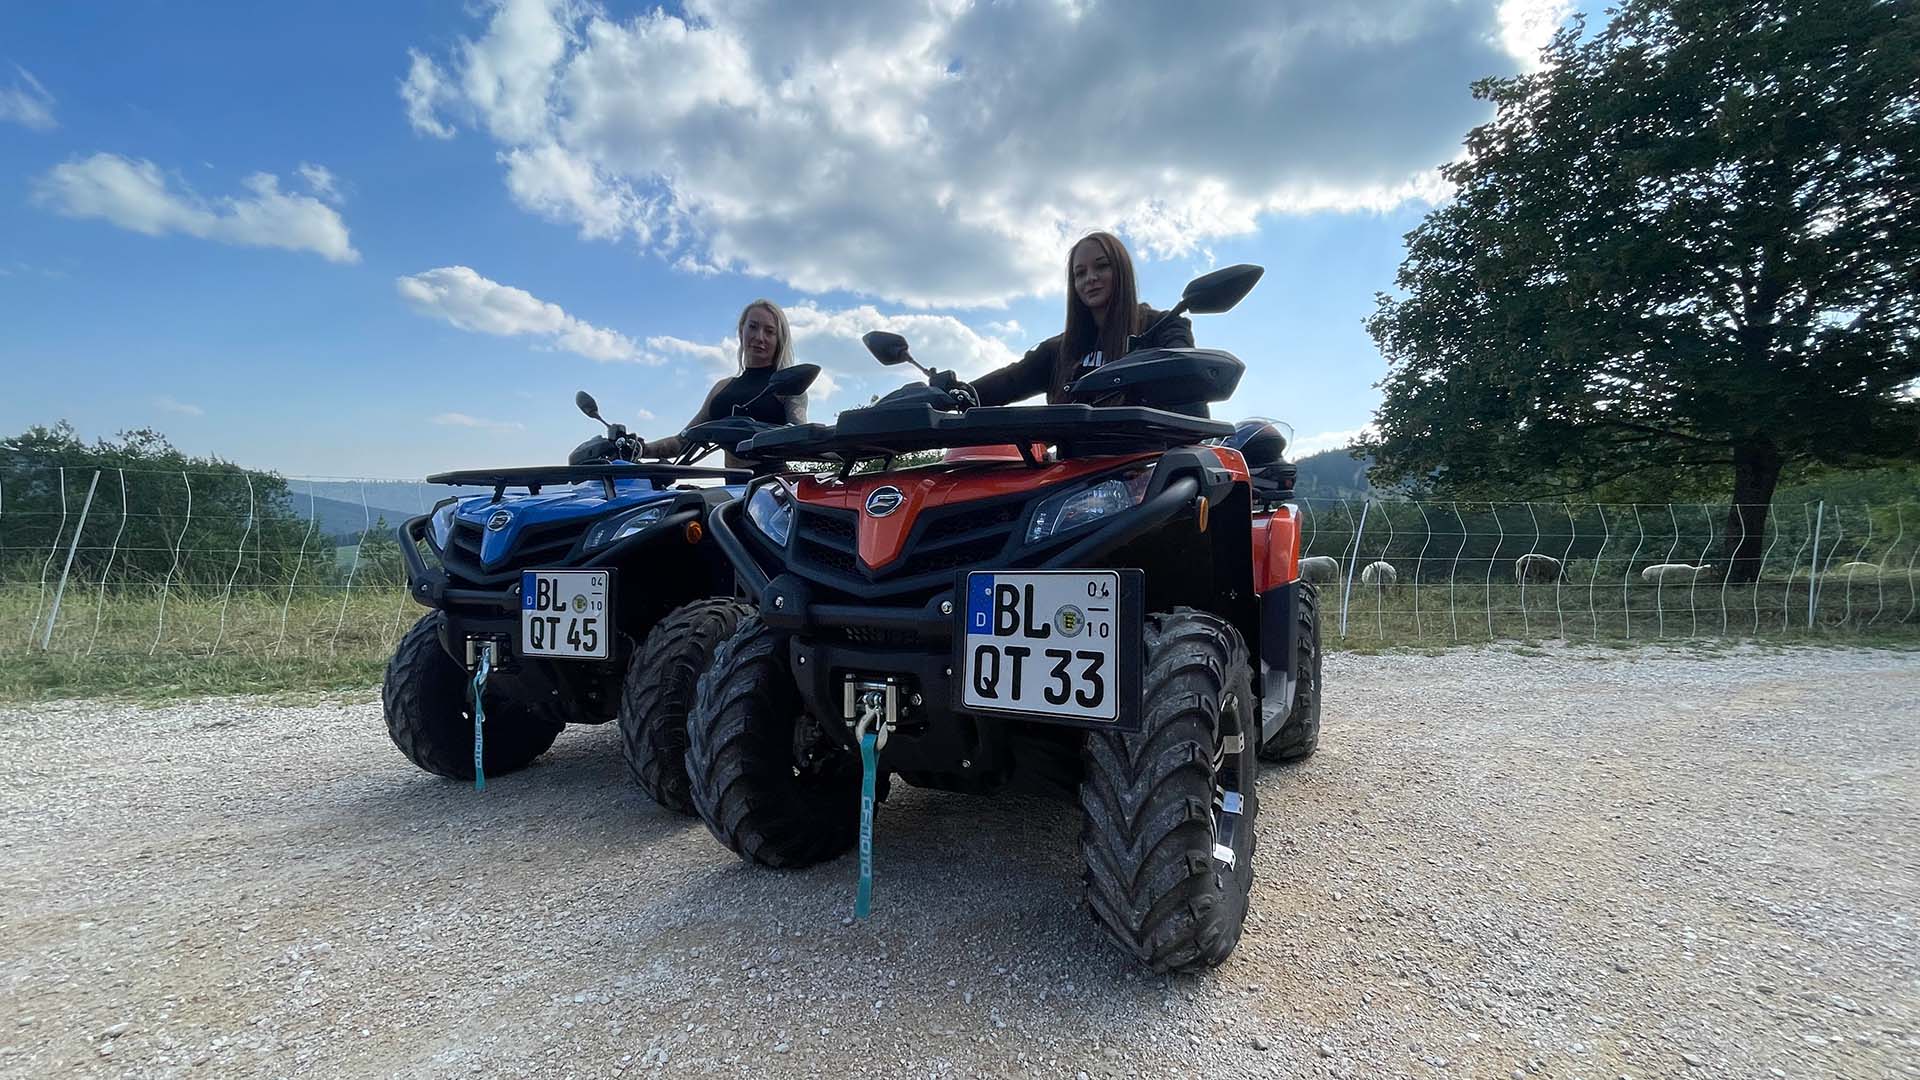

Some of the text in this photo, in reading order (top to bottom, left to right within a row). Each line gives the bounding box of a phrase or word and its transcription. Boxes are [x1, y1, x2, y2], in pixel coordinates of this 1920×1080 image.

[591, 577, 603, 586] 04
[1087, 581, 1110, 597] 04
[536, 578, 567, 612] BL
[590, 600, 603, 611] 10
[994, 583, 1051, 639] BL
[976, 612, 986, 627] D
[530, 616, 598, 652] QT 45
[1087, 621, 1109, 638] 10
[973, 644, 1105, 708] QT 33
